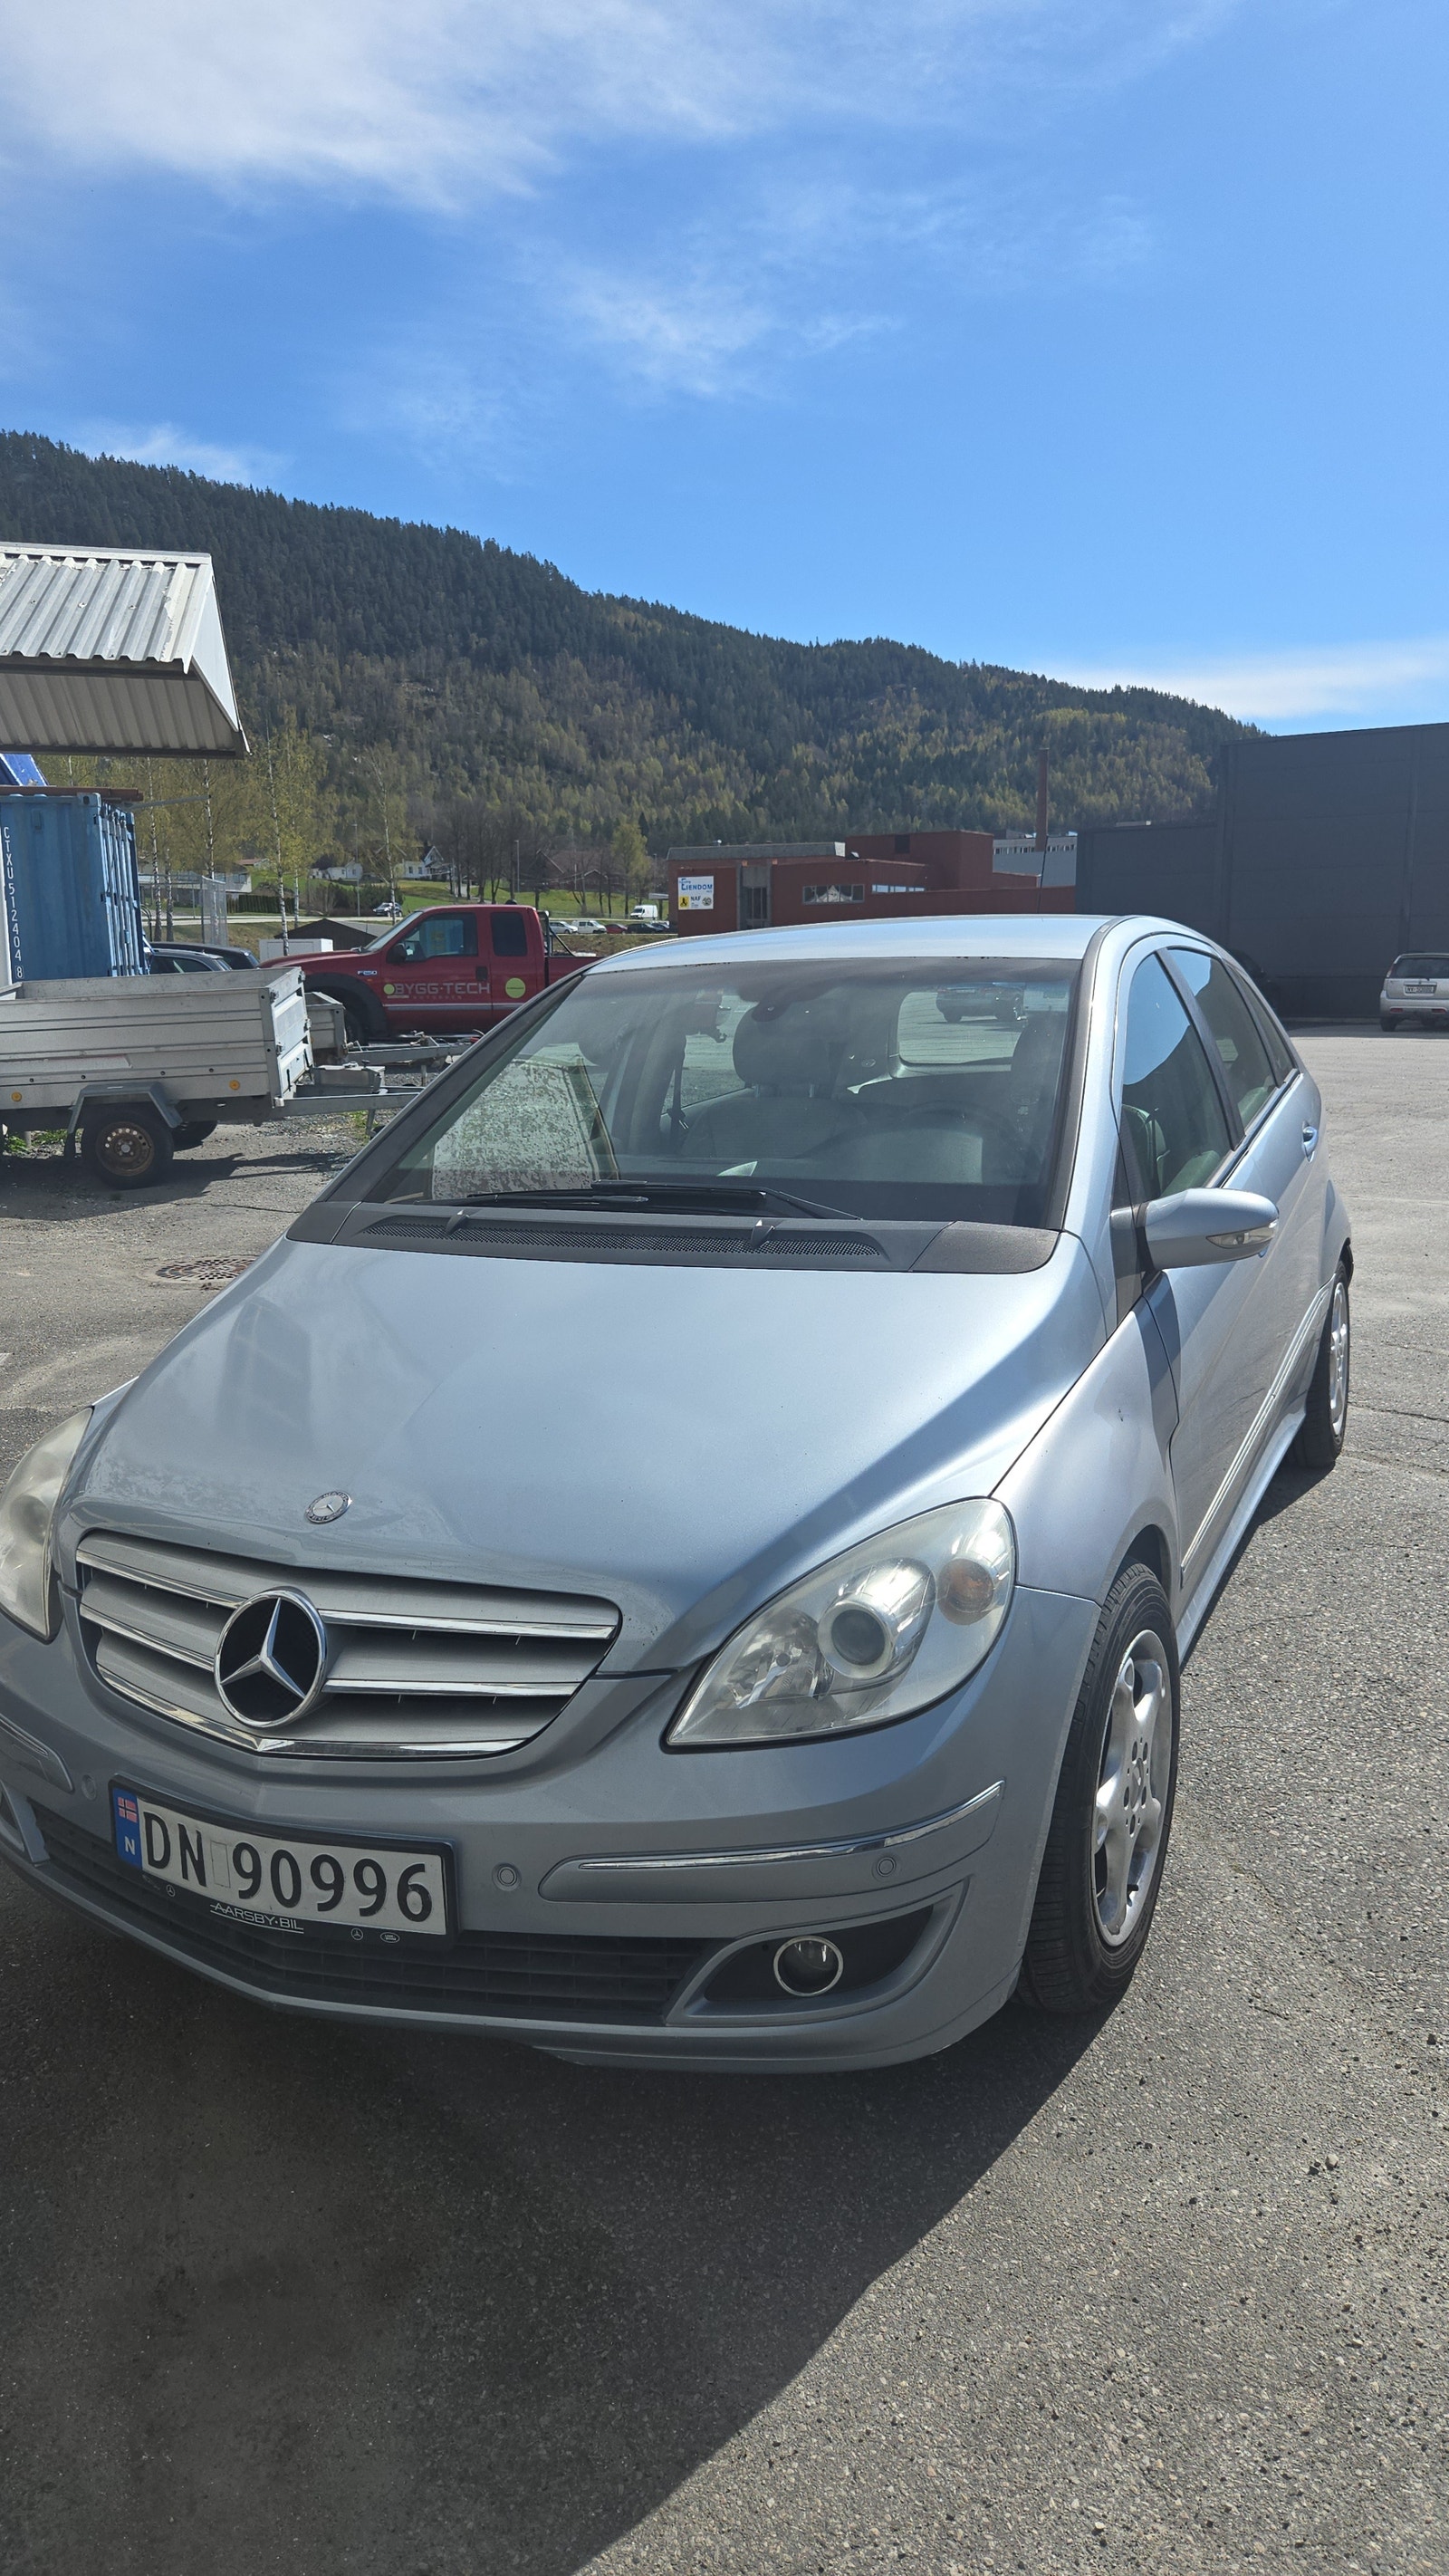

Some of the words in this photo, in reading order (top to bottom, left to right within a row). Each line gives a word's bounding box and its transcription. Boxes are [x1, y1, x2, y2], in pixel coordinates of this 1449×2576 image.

[4, 826, 14, 879] CTXU
[8, 882, 22, 962] 512404
[124, 1835, 136, 1856] N
[142, 1811, 207, 1888] DN
[232, 1841, 432, 1923] 90996
